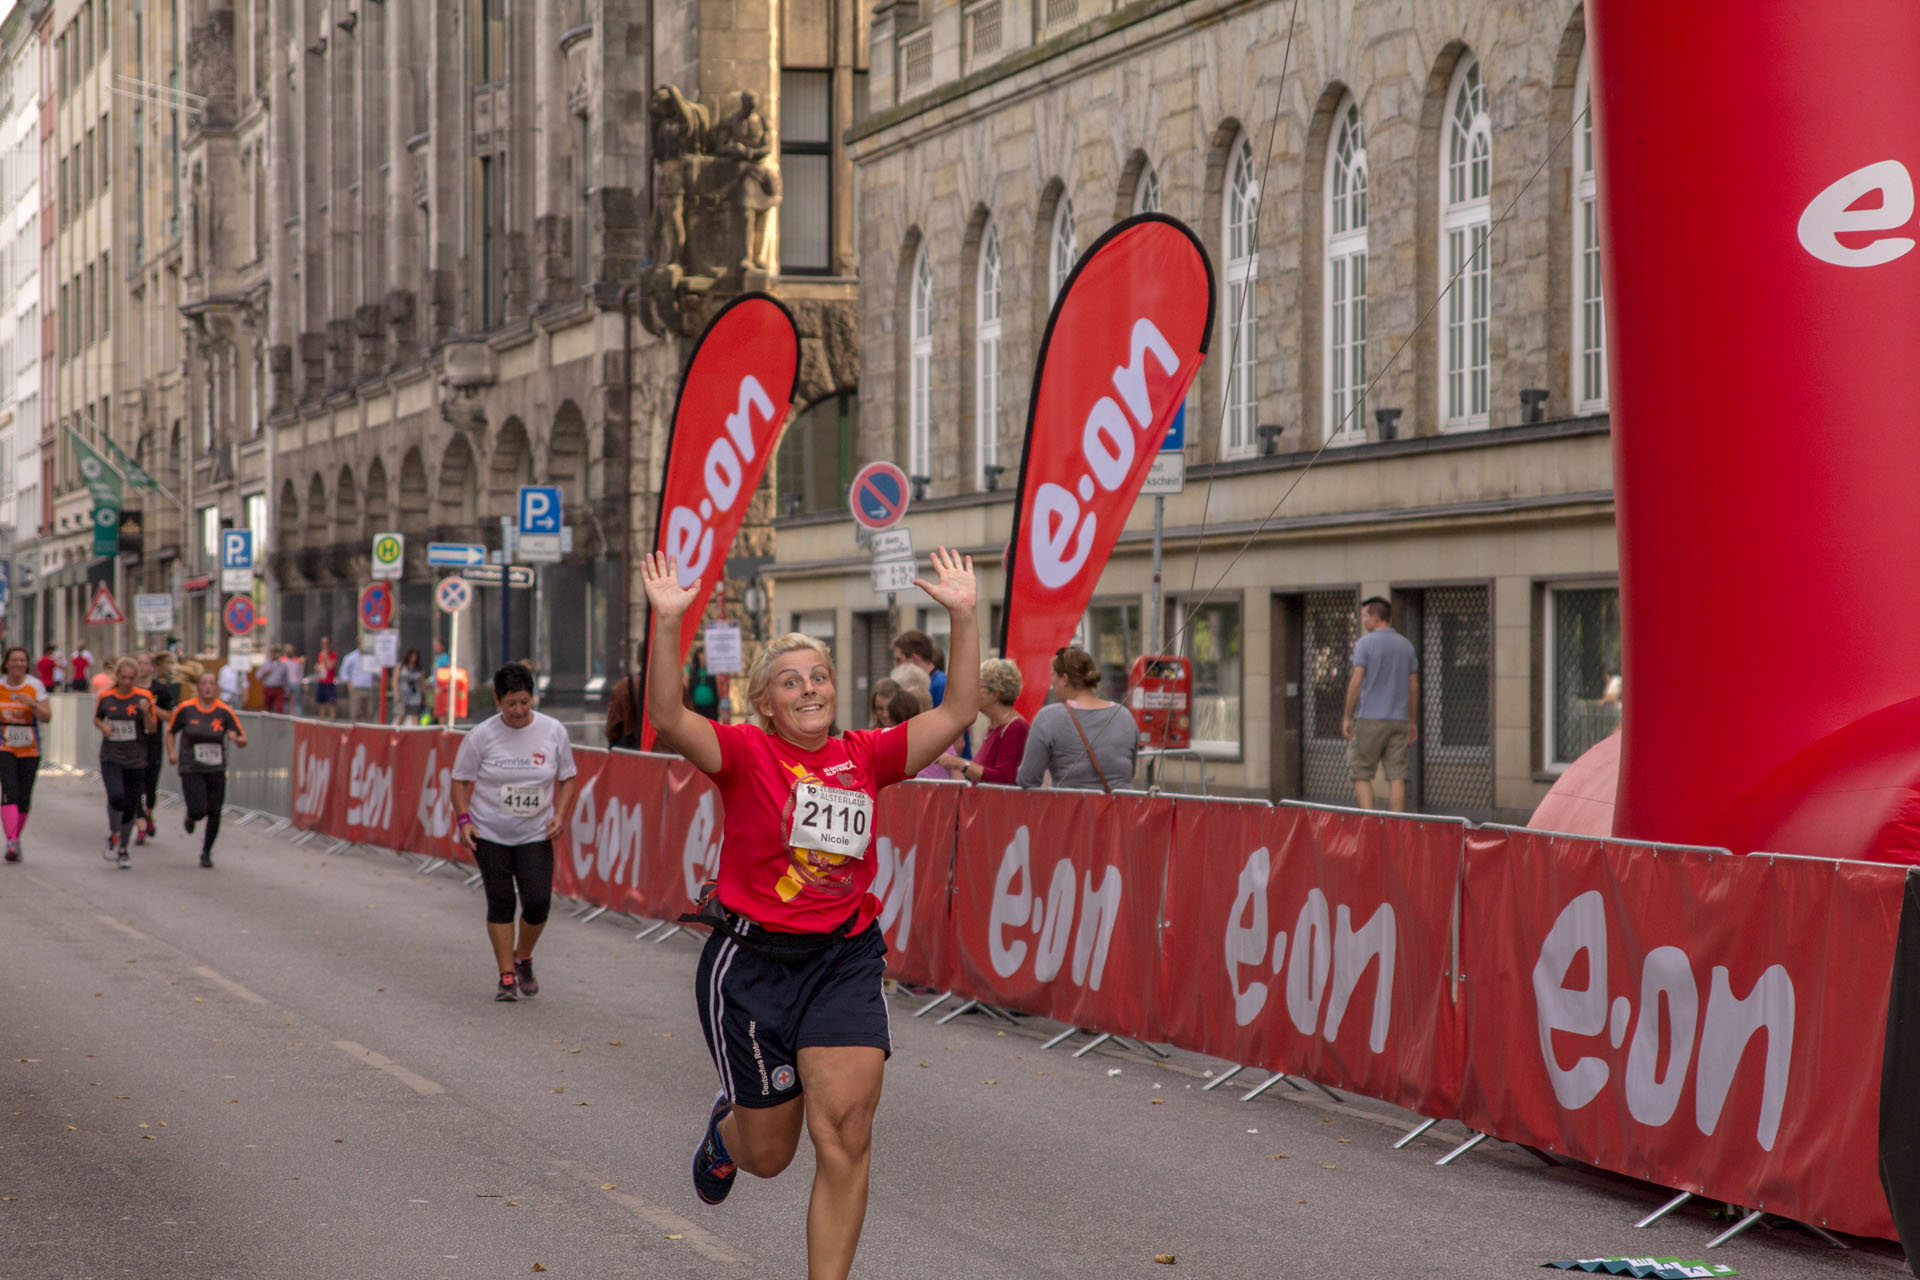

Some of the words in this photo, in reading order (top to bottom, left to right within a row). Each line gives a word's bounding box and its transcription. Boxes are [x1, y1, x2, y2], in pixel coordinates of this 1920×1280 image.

[525, 492, 550, 530] P
[227, 534, 245, 565] P
[504, 795, 539, 808] 4144
[820, 793, 866, 808] ALSTERLAUF
[802, 801, 865, 835] 2110
[821, 833, 849, 845] Nicole
[752, 1039, 761, 1060] Rote
[757, 1060, 769, 1095] Deutsches
